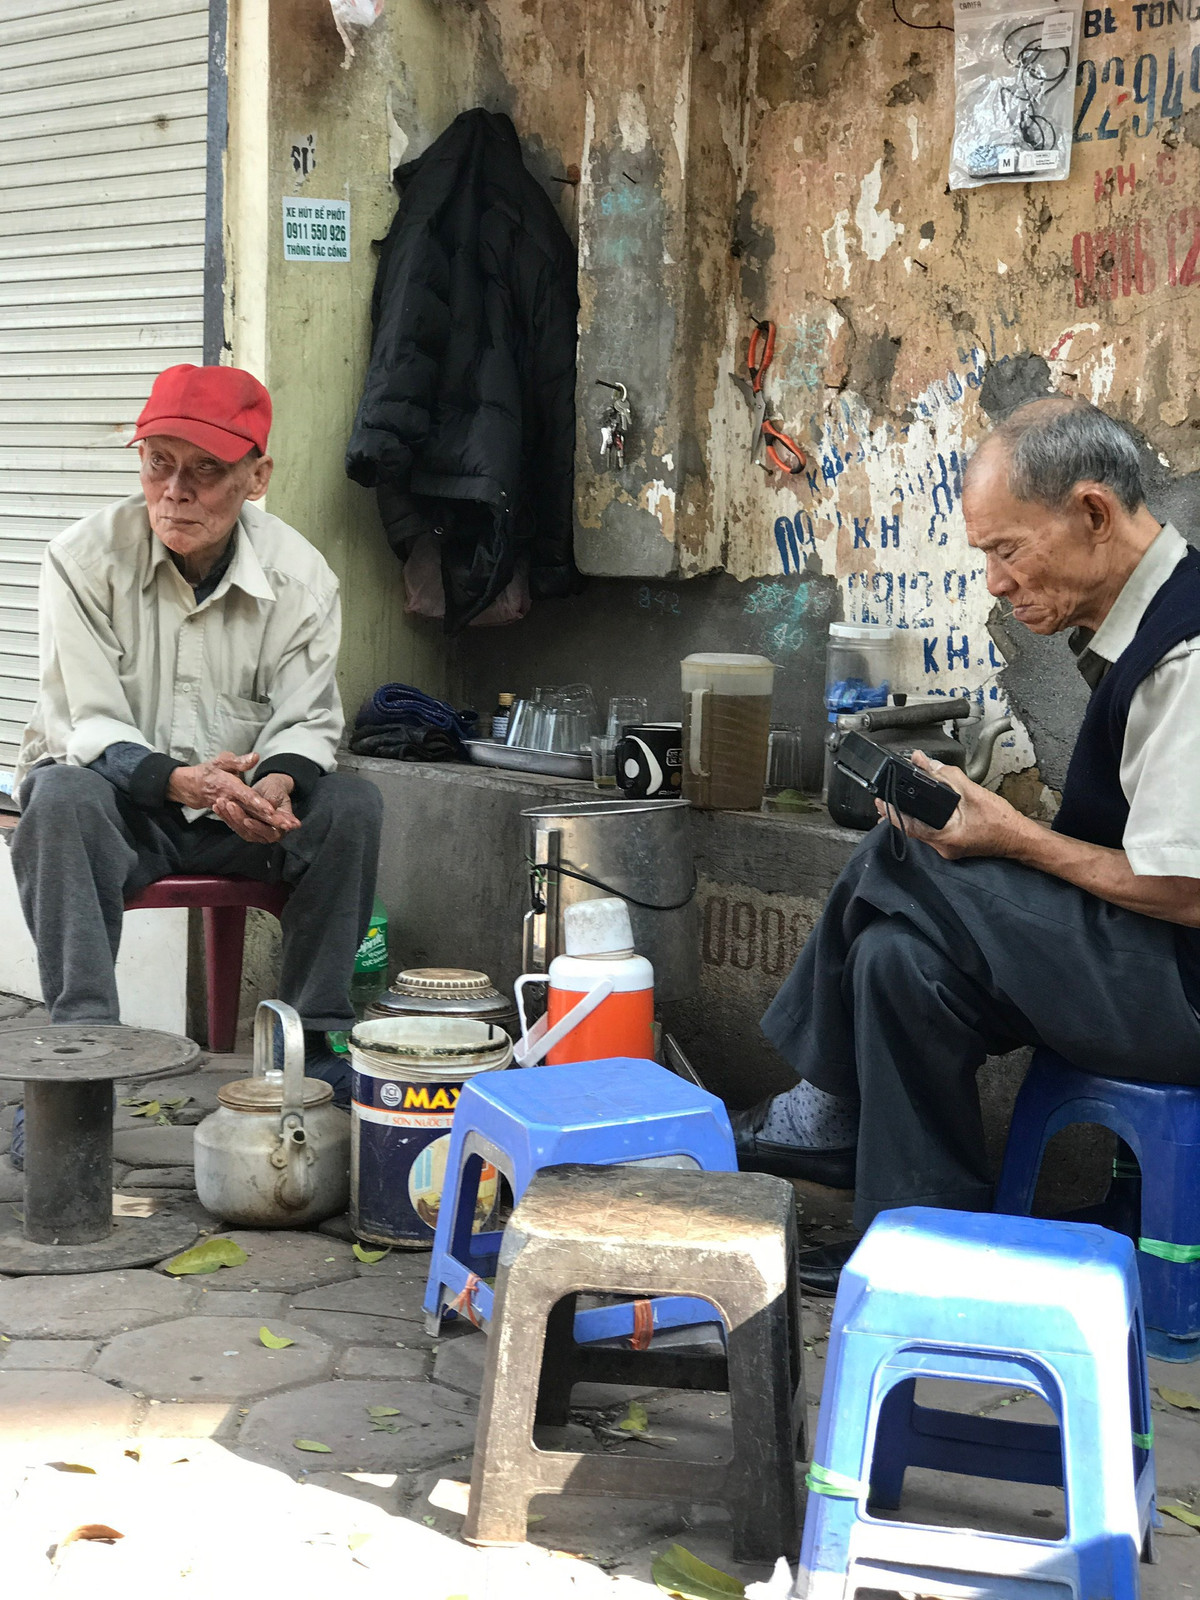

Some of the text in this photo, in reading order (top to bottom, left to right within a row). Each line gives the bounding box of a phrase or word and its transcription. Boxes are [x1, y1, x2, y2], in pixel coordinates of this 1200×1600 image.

[1002, 158, 1011, 168] M
[286, 206, 296, 218] XE
[298, 205, 313, 219] HÚT
[286, 221, 346, 242] 0911 550 926
[286, 242, 311, 256] THÔNG
[853, 514, 900, 549] KH
